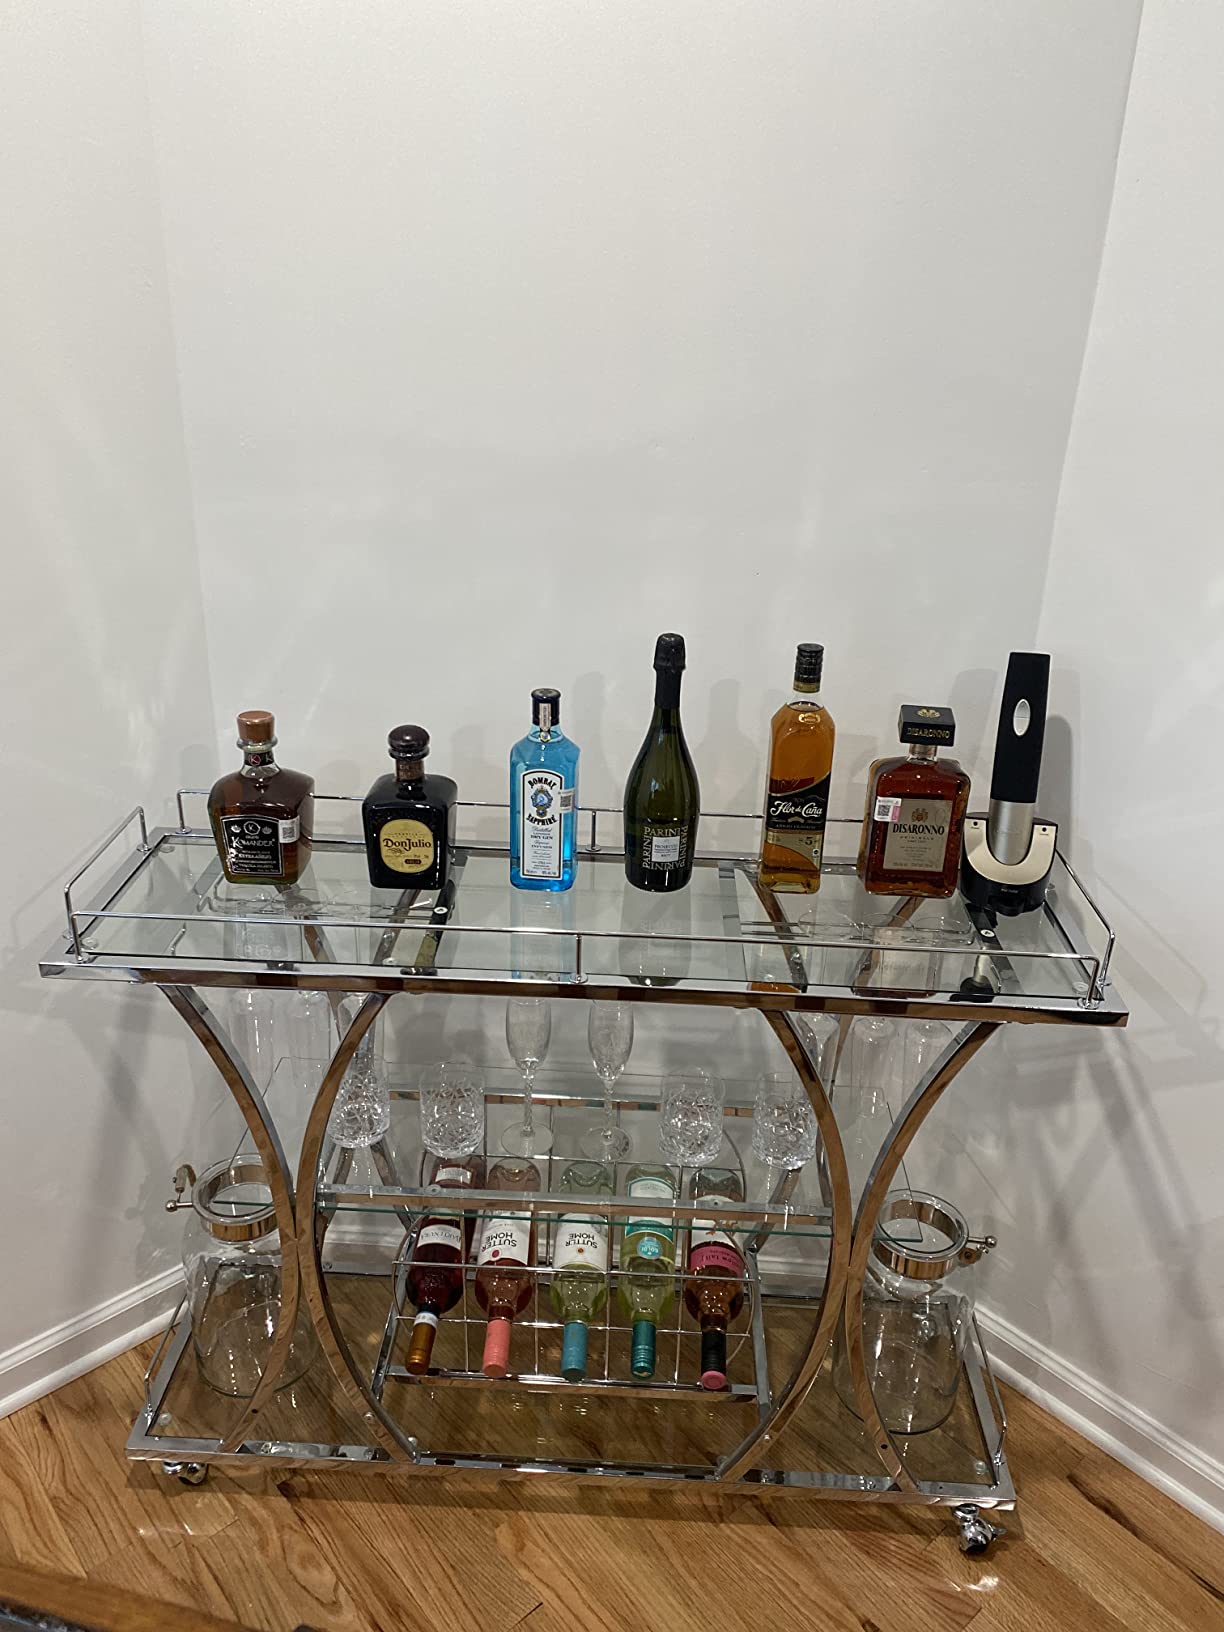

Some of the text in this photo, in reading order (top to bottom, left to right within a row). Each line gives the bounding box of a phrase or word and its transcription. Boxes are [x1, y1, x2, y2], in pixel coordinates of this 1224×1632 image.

[906, 727, 950, 739] DISARONNO
[527, 776, 557, 790] BOMBAY
[769, 800, 795, 816] Flor
[801, 802, 823, 818] Caña
[525, 812, 558, 826] SAPPHIRE
[643, 826, 681, 837] PARINI
[892, 822, 945, 836] DISARONNO
[804, 836, 814, 846] 5
[485, 1232, 513, 1243] HOME
[568, 1232, 595, 1240] HOME
[481, 1238, 518, 1252] SUTTER
[565, 1239, 598, 1249] SUTTER
